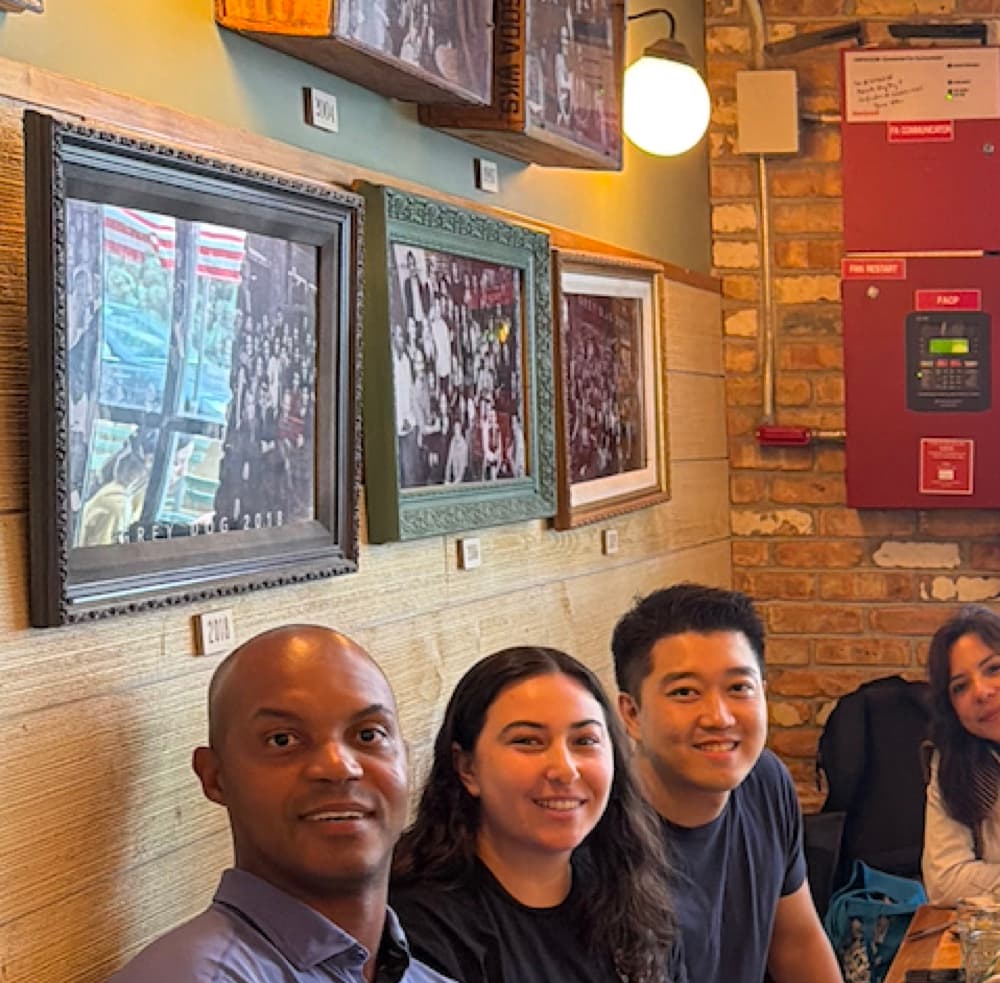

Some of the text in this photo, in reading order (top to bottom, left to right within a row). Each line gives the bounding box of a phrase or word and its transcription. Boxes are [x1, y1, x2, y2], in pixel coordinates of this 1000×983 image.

[866, 264, 898, 274] RESTART
[115, 510, 284, 545] GREY DOG 2018
[208, 616, 231, 644] 2018
